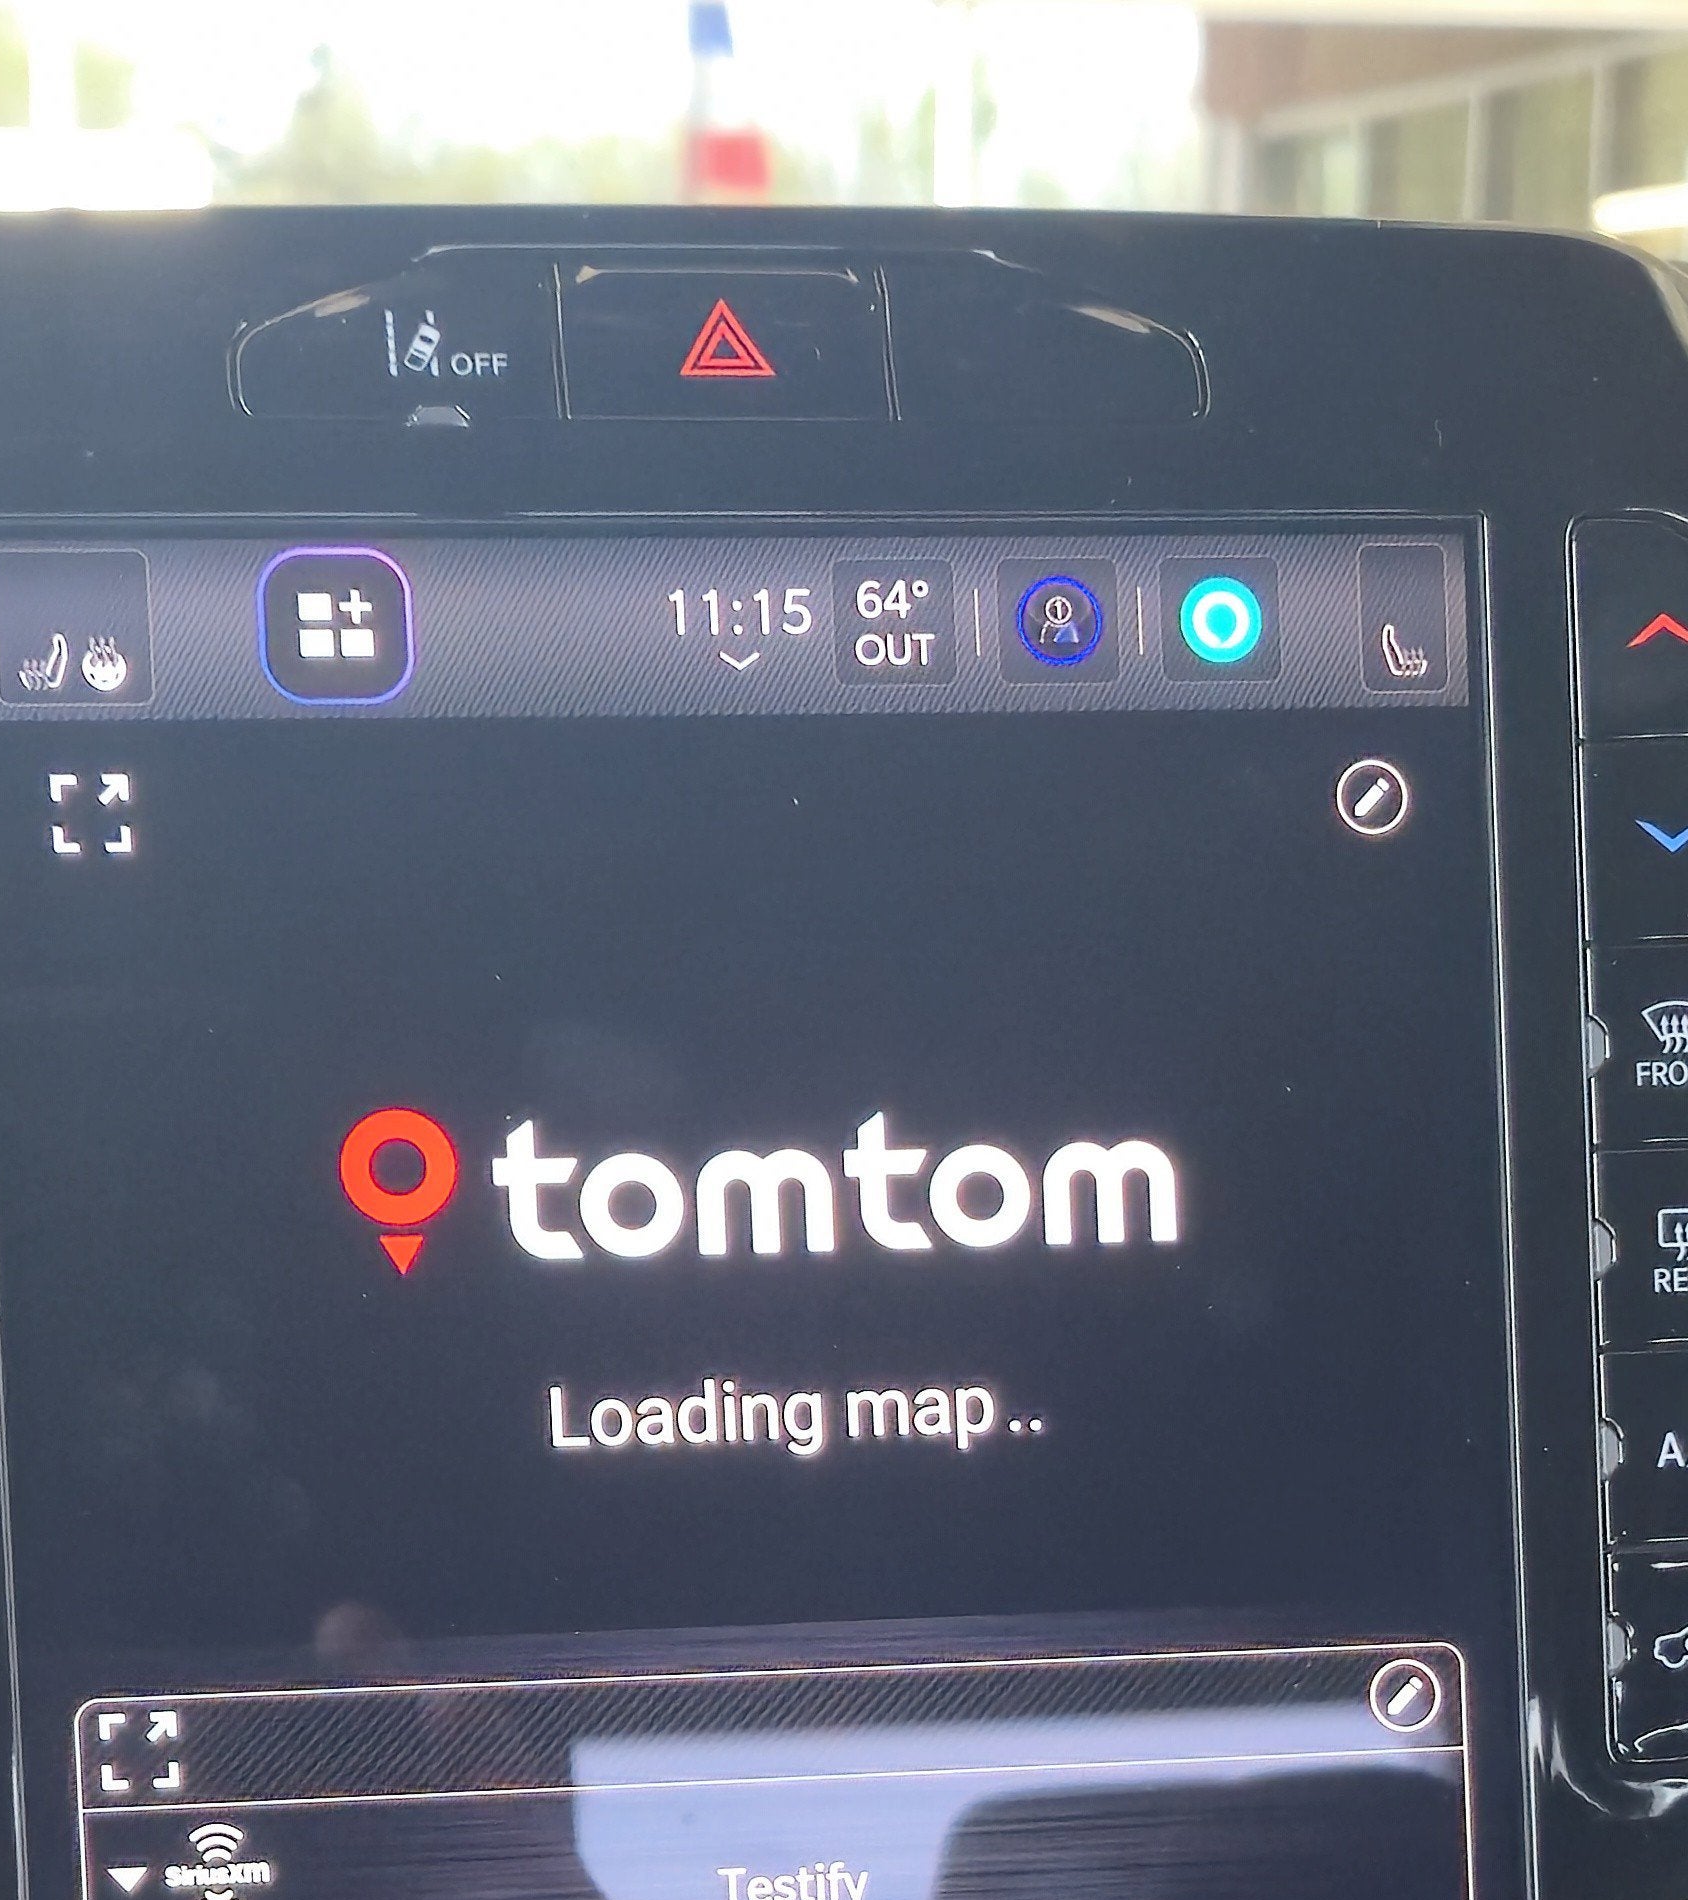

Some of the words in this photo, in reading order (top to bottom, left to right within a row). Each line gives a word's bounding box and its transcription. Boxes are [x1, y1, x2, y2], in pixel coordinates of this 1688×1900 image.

[451, 352, 508, 377] OFF
[667, 588, 813, 635] 11:15
[855, 580, 930, 621] 64°
[854, 633, 934, 667] OUT
[492, 1111, 1178, 1260] tomtom
[548, 1379, 825, 1456] Loading
